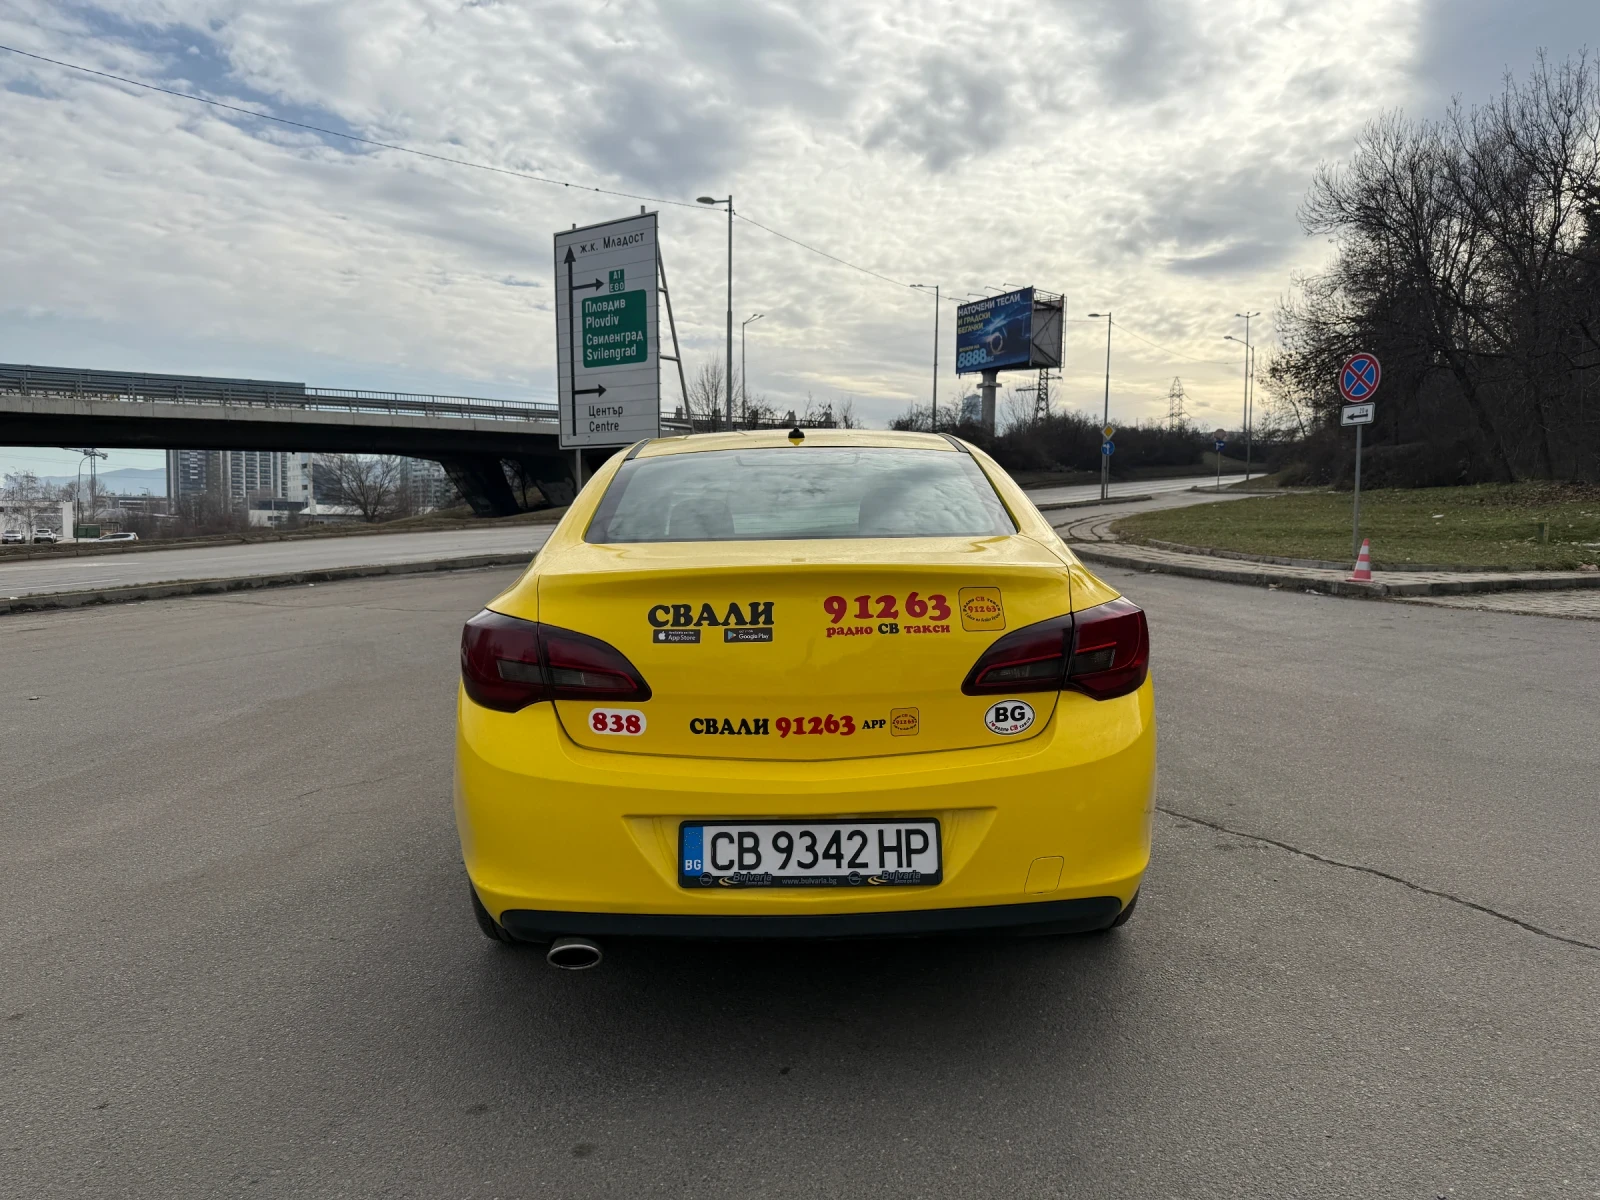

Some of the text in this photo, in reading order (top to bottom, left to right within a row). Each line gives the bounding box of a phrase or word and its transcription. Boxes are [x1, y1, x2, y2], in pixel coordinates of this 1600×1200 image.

[603, 232, 645, 250] Младост
[613, 271, 621, 280] A1
[609, 282, 625, 292] E80
[585, 299, 626, 313] Пловдив
[958, 293, 1021, 317] НАТОЧЕНИ ТЕСЛИ
[586, 314, 619, 329] Plovdiv
[586, 330, 644, 346] Свиленград
[586, 343, 637, 361] Svilengrad
[588, 405, 624, 418] Център
[589, 420, 620, 432] Centre
[823, 591, 952, 624] 91263
[967, 605, 997, 613] 91263
[647, 602, 775, 628] СВАЛИ
[903, 624, 951, 634] такси
[668, 634, 680, 642] App
[738, 632, 770, 641] Google Play
[994, 705, 1026, 723] BG
[592, 712, 642, 734] 838
[689, 717, 770, 736] СВАЛИ
[775, 713, 856, 739] 91263
[861, 719, 887, 730] APP
[771, 828, 869, 870] 9342
[685, 859, 702, 871] BG
[733, 872, 773, 882] Bulvaria
[781, 877, 838, 885] www.bulvaria.bg
[881, 870, 921, 880] Bulvaria
